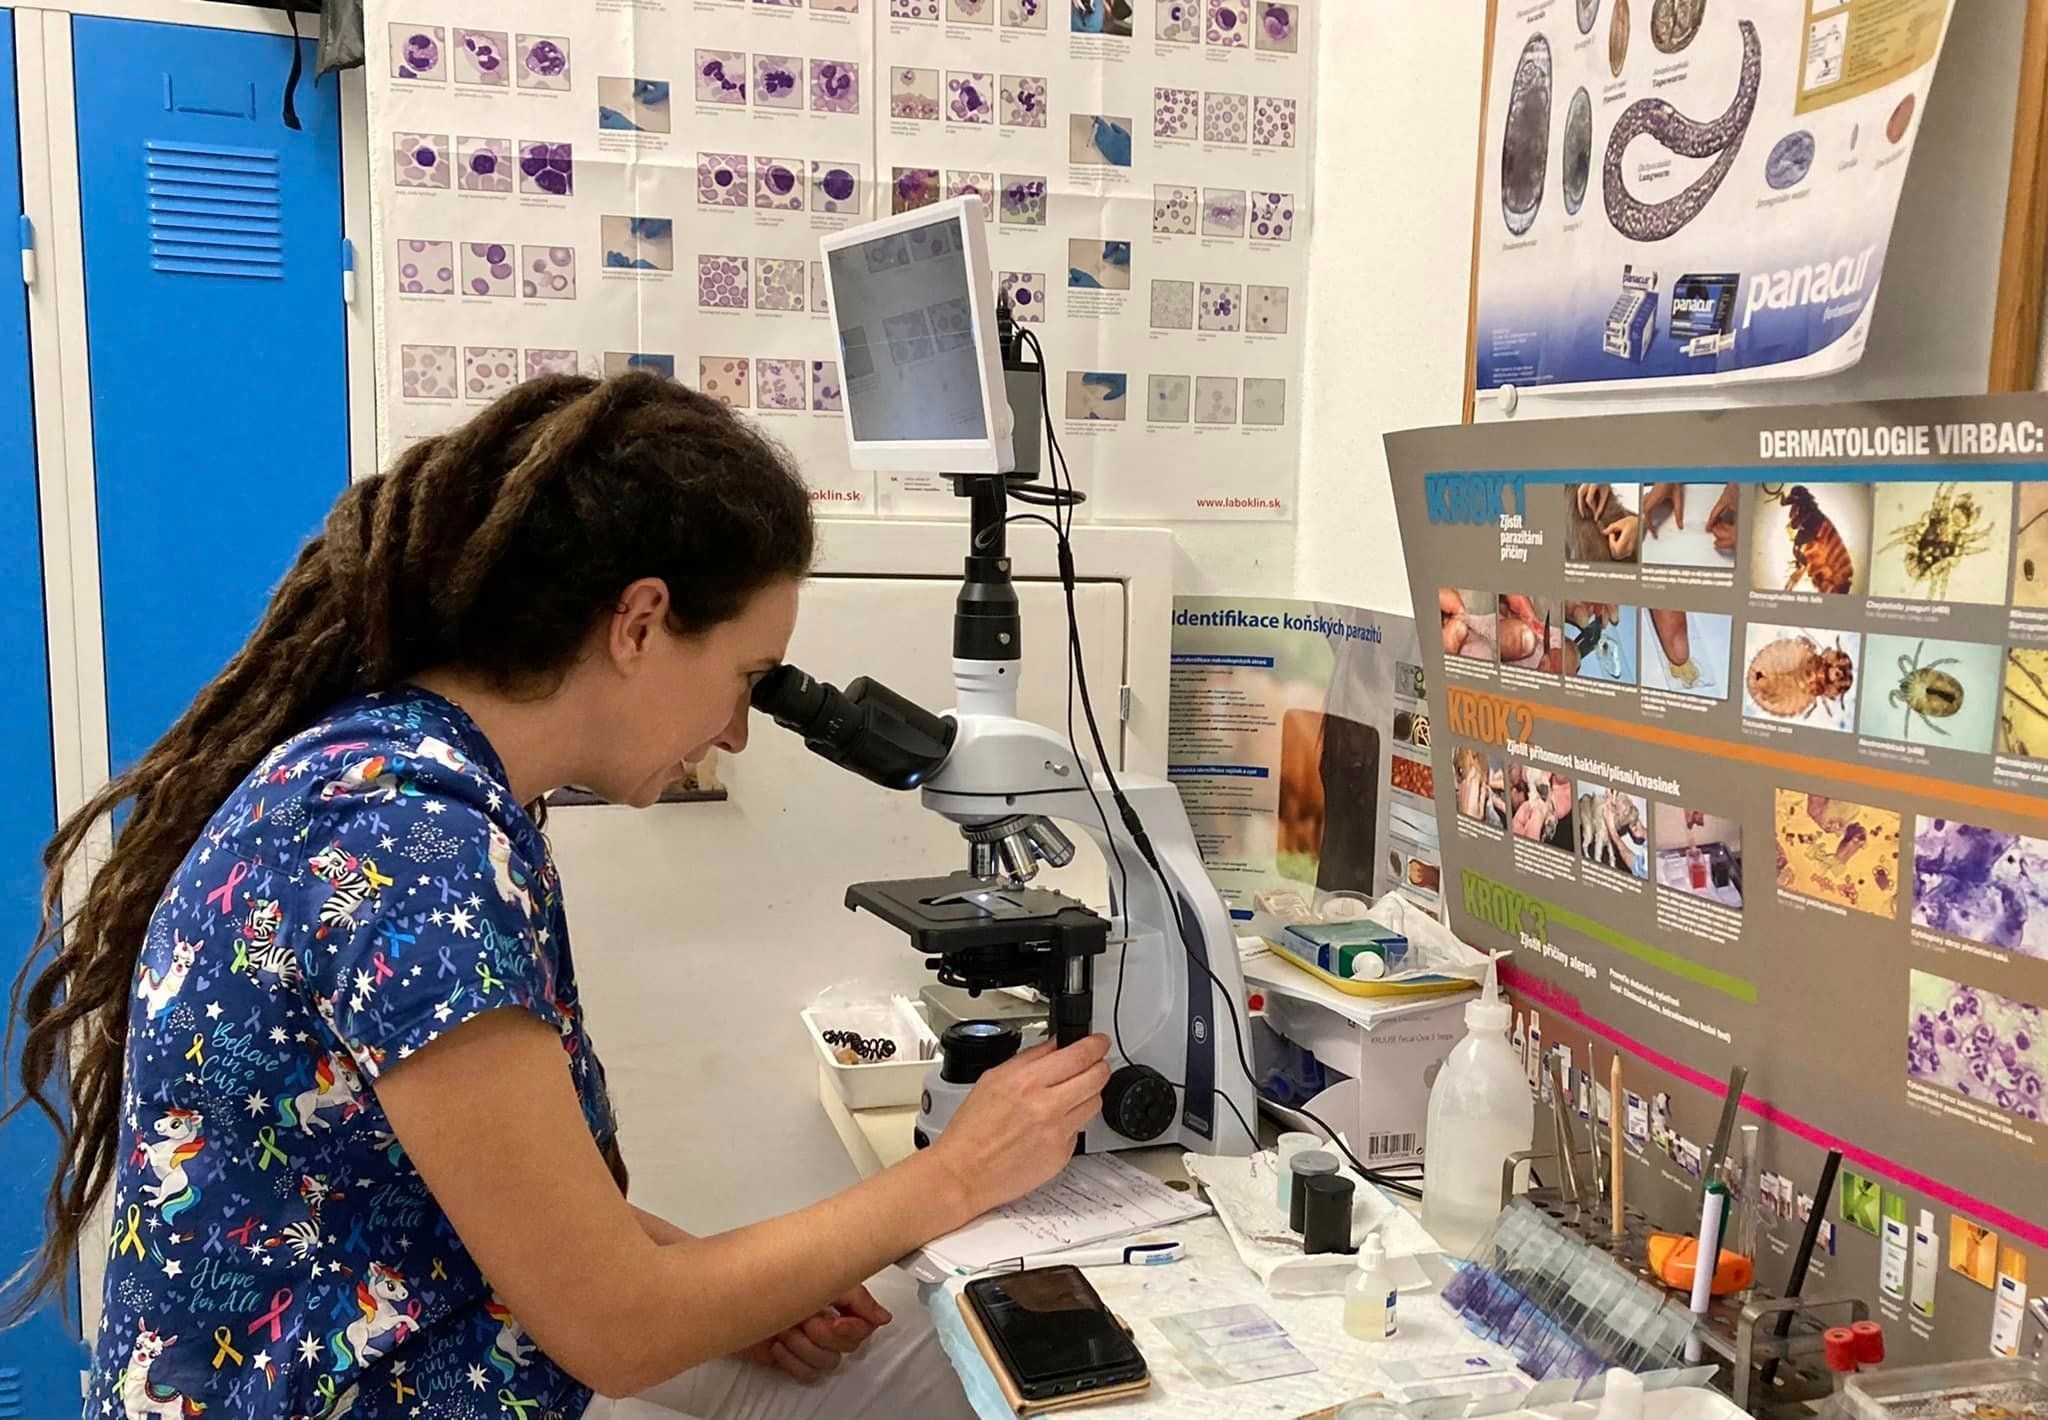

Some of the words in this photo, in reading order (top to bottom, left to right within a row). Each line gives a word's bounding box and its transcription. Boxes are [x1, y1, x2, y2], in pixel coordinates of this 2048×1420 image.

[1742, 244, 1876, 329] panacur
[1673, 298, 1715, 316] panacur
[1759, 425, 1930, 458] DERMATOLOGIE
[1934, 421, 2044, 455] VIRBAC:
[1196, 497, 1281, 509] www.laboklin.sk
[1424, 472, 1504, 525] KROK
[1509, 474, 1525, 517] 1
[1500, 529, 1543, 546] parazitární
[1500, 544, 1528, 563] příčiny
[1172, 608, 1280, 629] Identifikace
[1283, 612, 1345, 638] koňských
[1447, 686, 1510, 744] KROK
[1515, 704, 1534, 745] 2
[1528, 743, 1574, 769] přítomnost
[1462, 866, 1524, 936] KROK
[1527, 900, 1549, 945] 3
[1542, 941, 1570, 968] příčiny
[1569, 955, 1598, 979] alergie
[211, 1021, 280, 1072] Believe
[221, 1053, 242, 1074] in
[200, 1054, 249, 1097] Cure
[190, 1257, 256, 1291] Hope
[187, 1287, 217, 1314] for
[218, 1289, 262, 1314] All
[424, 1356, 446, 1375] in
[415, 1367, 465, 1401] Cure
